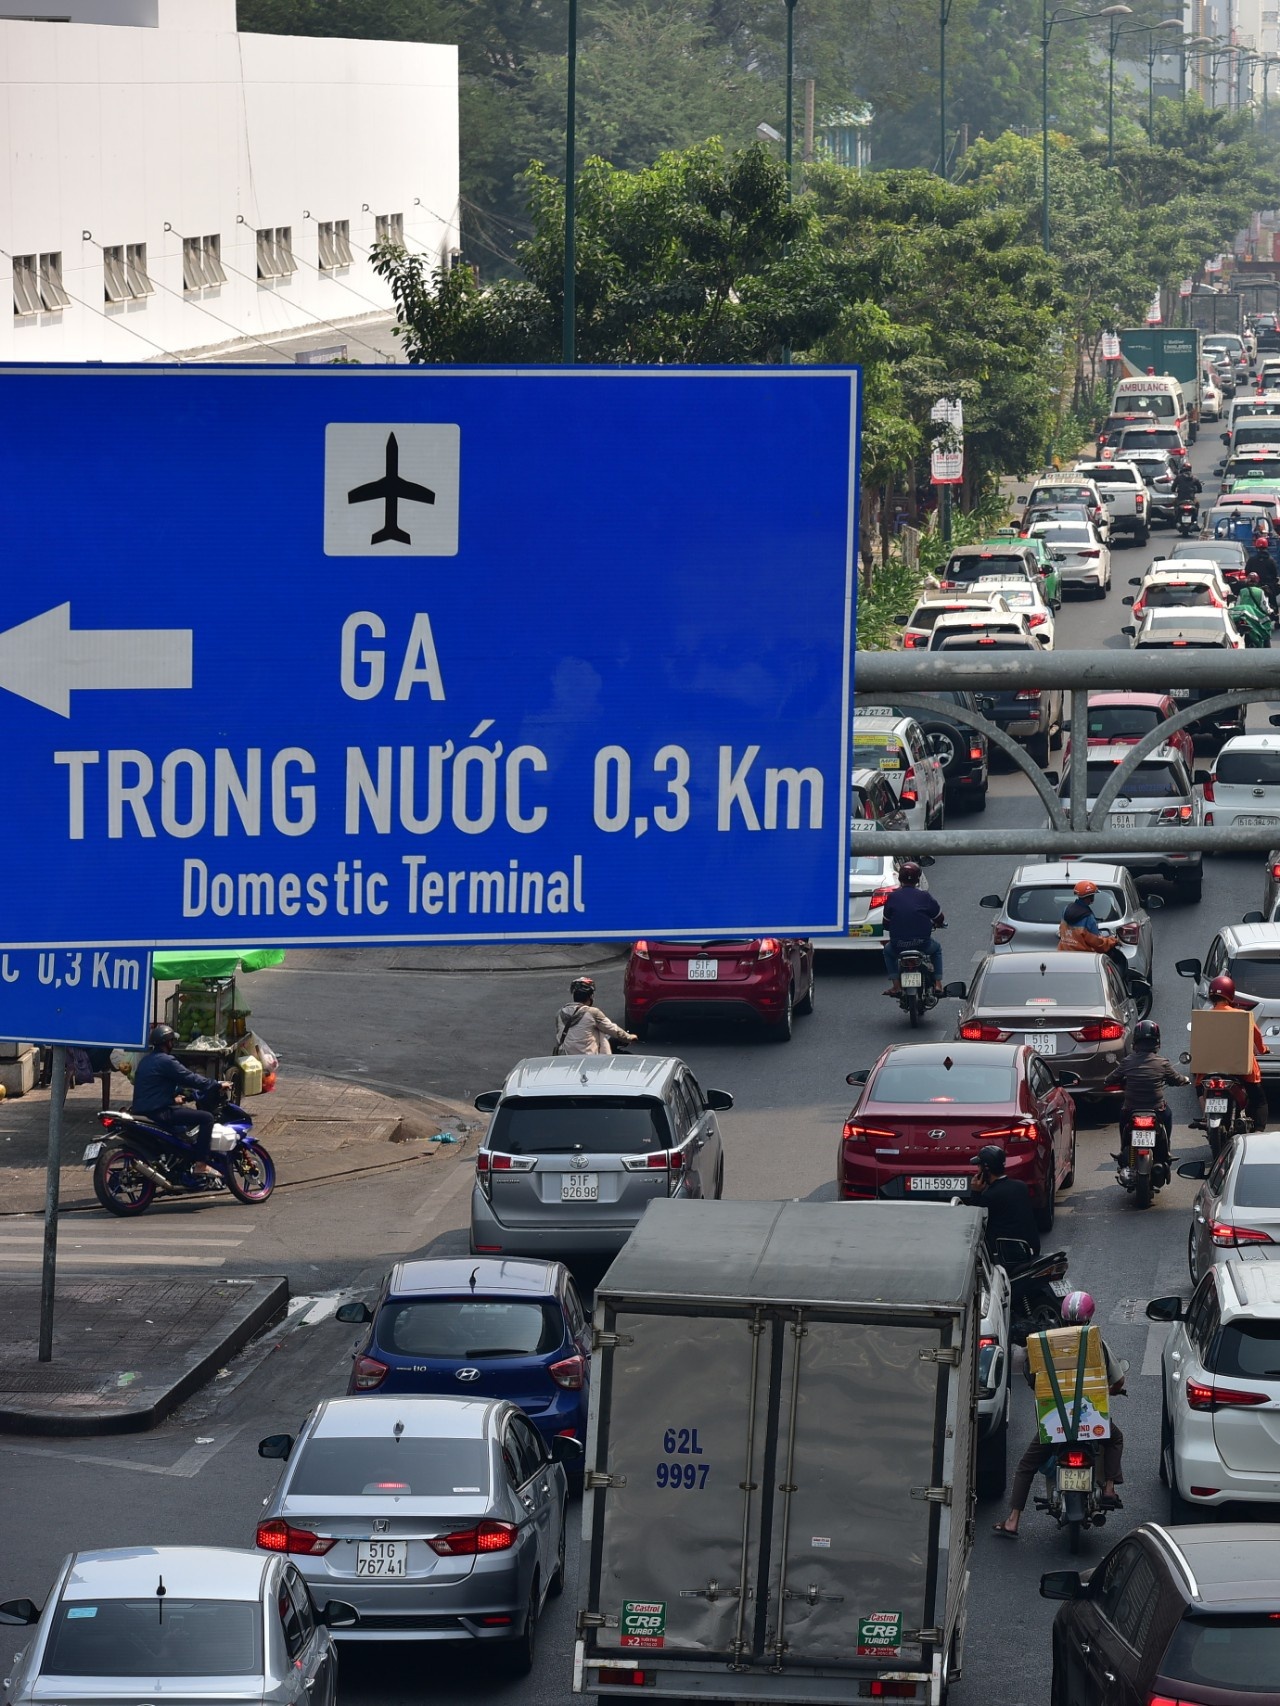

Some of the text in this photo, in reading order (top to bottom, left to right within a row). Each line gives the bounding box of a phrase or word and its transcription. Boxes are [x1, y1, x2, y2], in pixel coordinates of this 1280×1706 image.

[1119, 383, 1169, 392] AMBULANCE
[340, 611, 446, 701] GA
[54, 719, 824, 840] TRONG NƯỚC 0,3 Km
[1116, 815, 1130, 824] 61A
[864, 823, 875, 832] 27
[183, 854, 585, 917] Domestic Terminal
[92, 951, 139, 990] Km
[695, 960, 710, 970] 51F
[689, 969, 717, 979] 058.90
[1032, 1035, 1049, 1044] 51G
[570, 1174, 590, 1187] 51F
[911, 1178, 967, 1190] 51H-599.79
[562, 1187, 598, 1198] 926.98
[663, 1428, 704, 1455] 62L
[656, 1462, 710, 1490] 9997
[369, 1543, 395, 1559] 51G
[358, 1559, 404, 1575] 767.41
[635, 1604, 660, 1612] Castrol
[625, 1615, 662, 1628] CRB
[871, 1613, 897, 1622] Castrol
[861, 1625, 898, 1637] CRB
